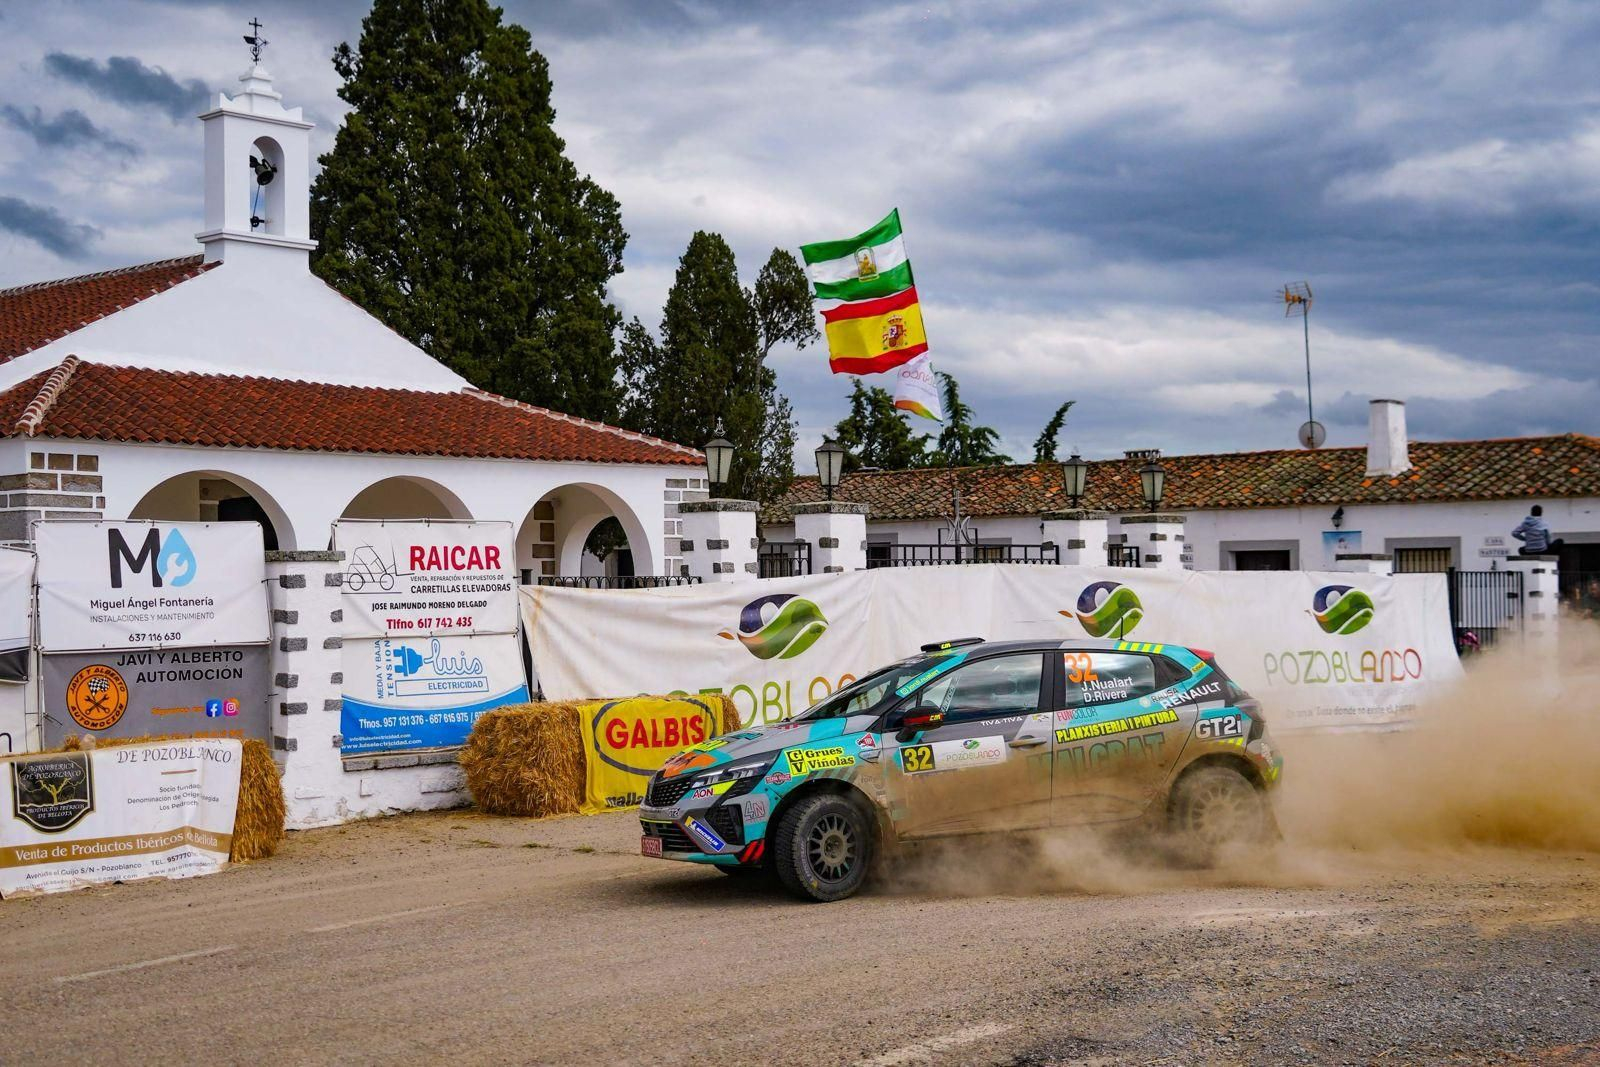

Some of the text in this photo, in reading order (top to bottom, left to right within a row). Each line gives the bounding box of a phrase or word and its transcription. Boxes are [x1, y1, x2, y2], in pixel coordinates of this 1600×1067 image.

[410, 545, 501, 571] RAICAR
[430, 574, 460, 582] REPARACIÓN
[411, 583, 511, 594] CARRETILLAS ELEVADORAS
[90, 596, 214, 611] Miguel Ángel Fontanería
[372, 600, 487, 611] JOSE RAIMUNDO MORENO DELGADO
[90, 614, 149, 623] INSTALACIONES
[157, 612, 215, 621] MANTENIMIENTO
[417, 618, 432, 628] 617
[436, 617, 453, 628] 742
[456, 617, 472, 627] 435
[129, 632, 181, 642] 637 116 630
[117, 650, 243, 666] JAVI Y ALBERTO
[136, 665, 243, 683] AUTOMOCIÓN
[386, 640, 395, 698] TENSION
[1064, 651, 1098, 684] 32
[1264, 648, 1422, 686] POZOBLANCO
[94, 667, 125, 692] ALBERTO
[376, 673, 385, 699] MEDIA
[428, 680, 483, 691] ELECTRICIDAD
[1081, 676, 1134, 692] J.Nualart
[1083, 689, 1127, 703] D.Rivera
[1160, 681, 1222, 710] RENAULT
[359, 718, 382, 729] Tfnos.
[383, 717, 396, 728] 957
[399, 715, 411, 726] 131
[411, 714, 424, 725] 376
[429, 714, 442, 724] 667
[444, 713, 456, 723] 615
[456, 712, 469, 722] 975
[1056, 706, 1098, 721] FUNCOLOR
[605, 715, 704, 750] GALBIS
[1056, 710, 1178, 743] PLANXISTERIA I PINTURA
[1195, 714, 1242, 739] GT2i
[341, 738, 422, 749] www.luiselectricidad.com
[117, 746, 232, 763] DE POZOBLANCO
[805, 747, 843, 758] Grues
[904, 746, 933, 772] 32
[807, 756, 855, 769] Viñolas
[693, 788, 714, 799] AON
[15, 848, 48, 861] Venta
[51, 845, 68, 857] de
[72, 841, 133, 855] Productos
[136, 832, 184, 849] Ibéricos
[194, 832, 218, 847] Bellota
[26, 871, 53, 880] Avenida
[80, 866, 95, 875] S/N
[101, 863, 142, 872] Pozoblanco
